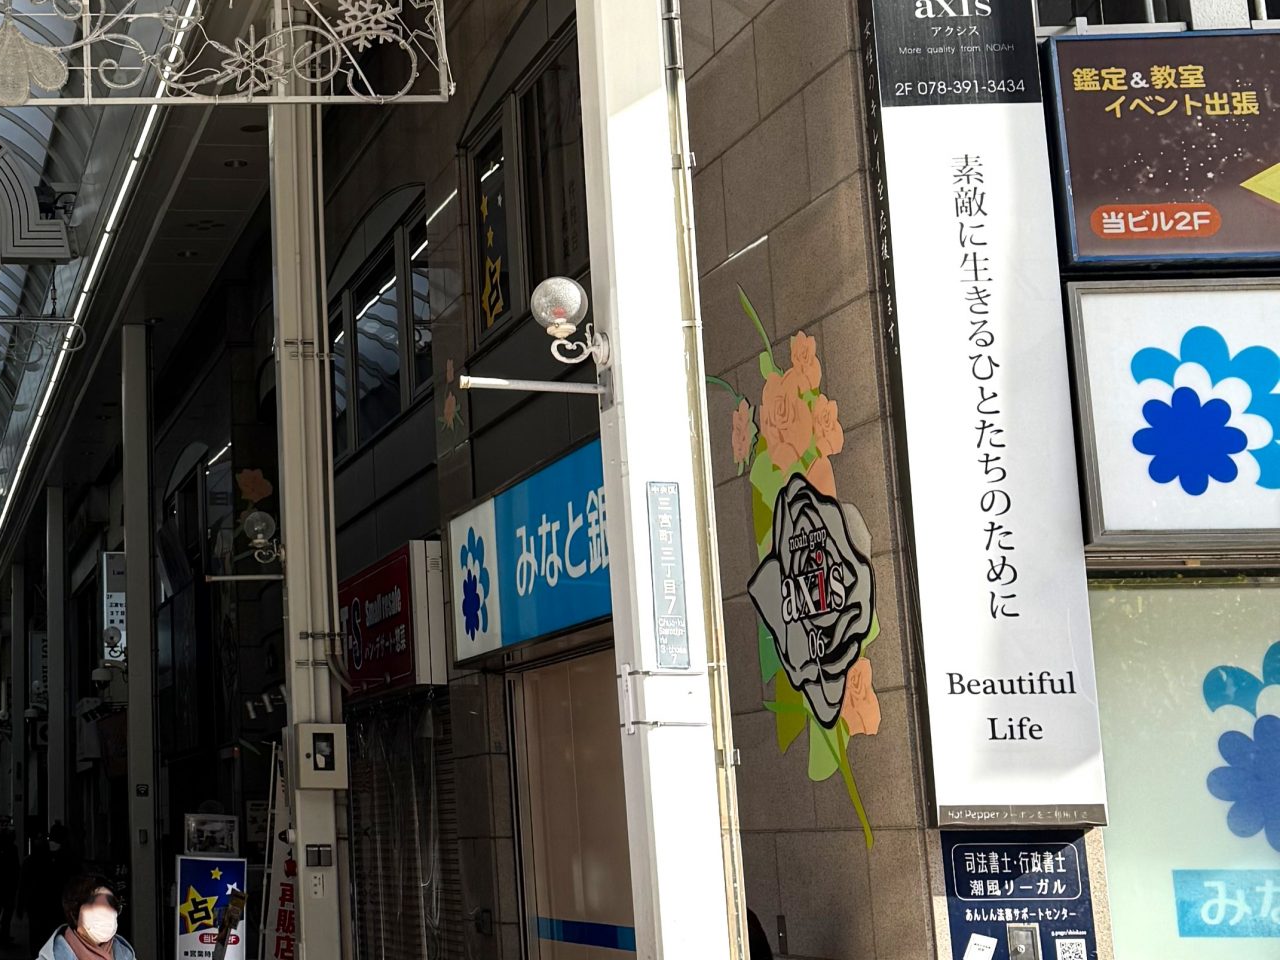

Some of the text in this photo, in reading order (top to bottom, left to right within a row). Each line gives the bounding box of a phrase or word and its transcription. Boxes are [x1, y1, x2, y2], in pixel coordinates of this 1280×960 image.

[931, 25, 980, 37] アクシス
[898, 43, 1015, 55] More quality from NOAH
[895, 79, 1026, 96] 2F 078-391-3434
[1071, 63, 1207, 92] 鑑定&教室
[1104, 91, 1261, 119] イベント出張
[1101, 208, 1212, 234] 当ビル2F
[950, 153, 1021, 620] 素敵に生きるひとたちのために
[789, 528, 827, 551] noah grop
[781, 549, 846, 623] axis
[945, 670, 1077, 695] Beautiful
[987, 716, 1044, 740] Life
[963, 851, 1067, 874] 司法書士・行政書士
[969, 878, 1067, 897] 潮風リーガル
[188, 897, 211, 925] 占
[965, 907, 1077, 922] あんしん法務サポートセンター
